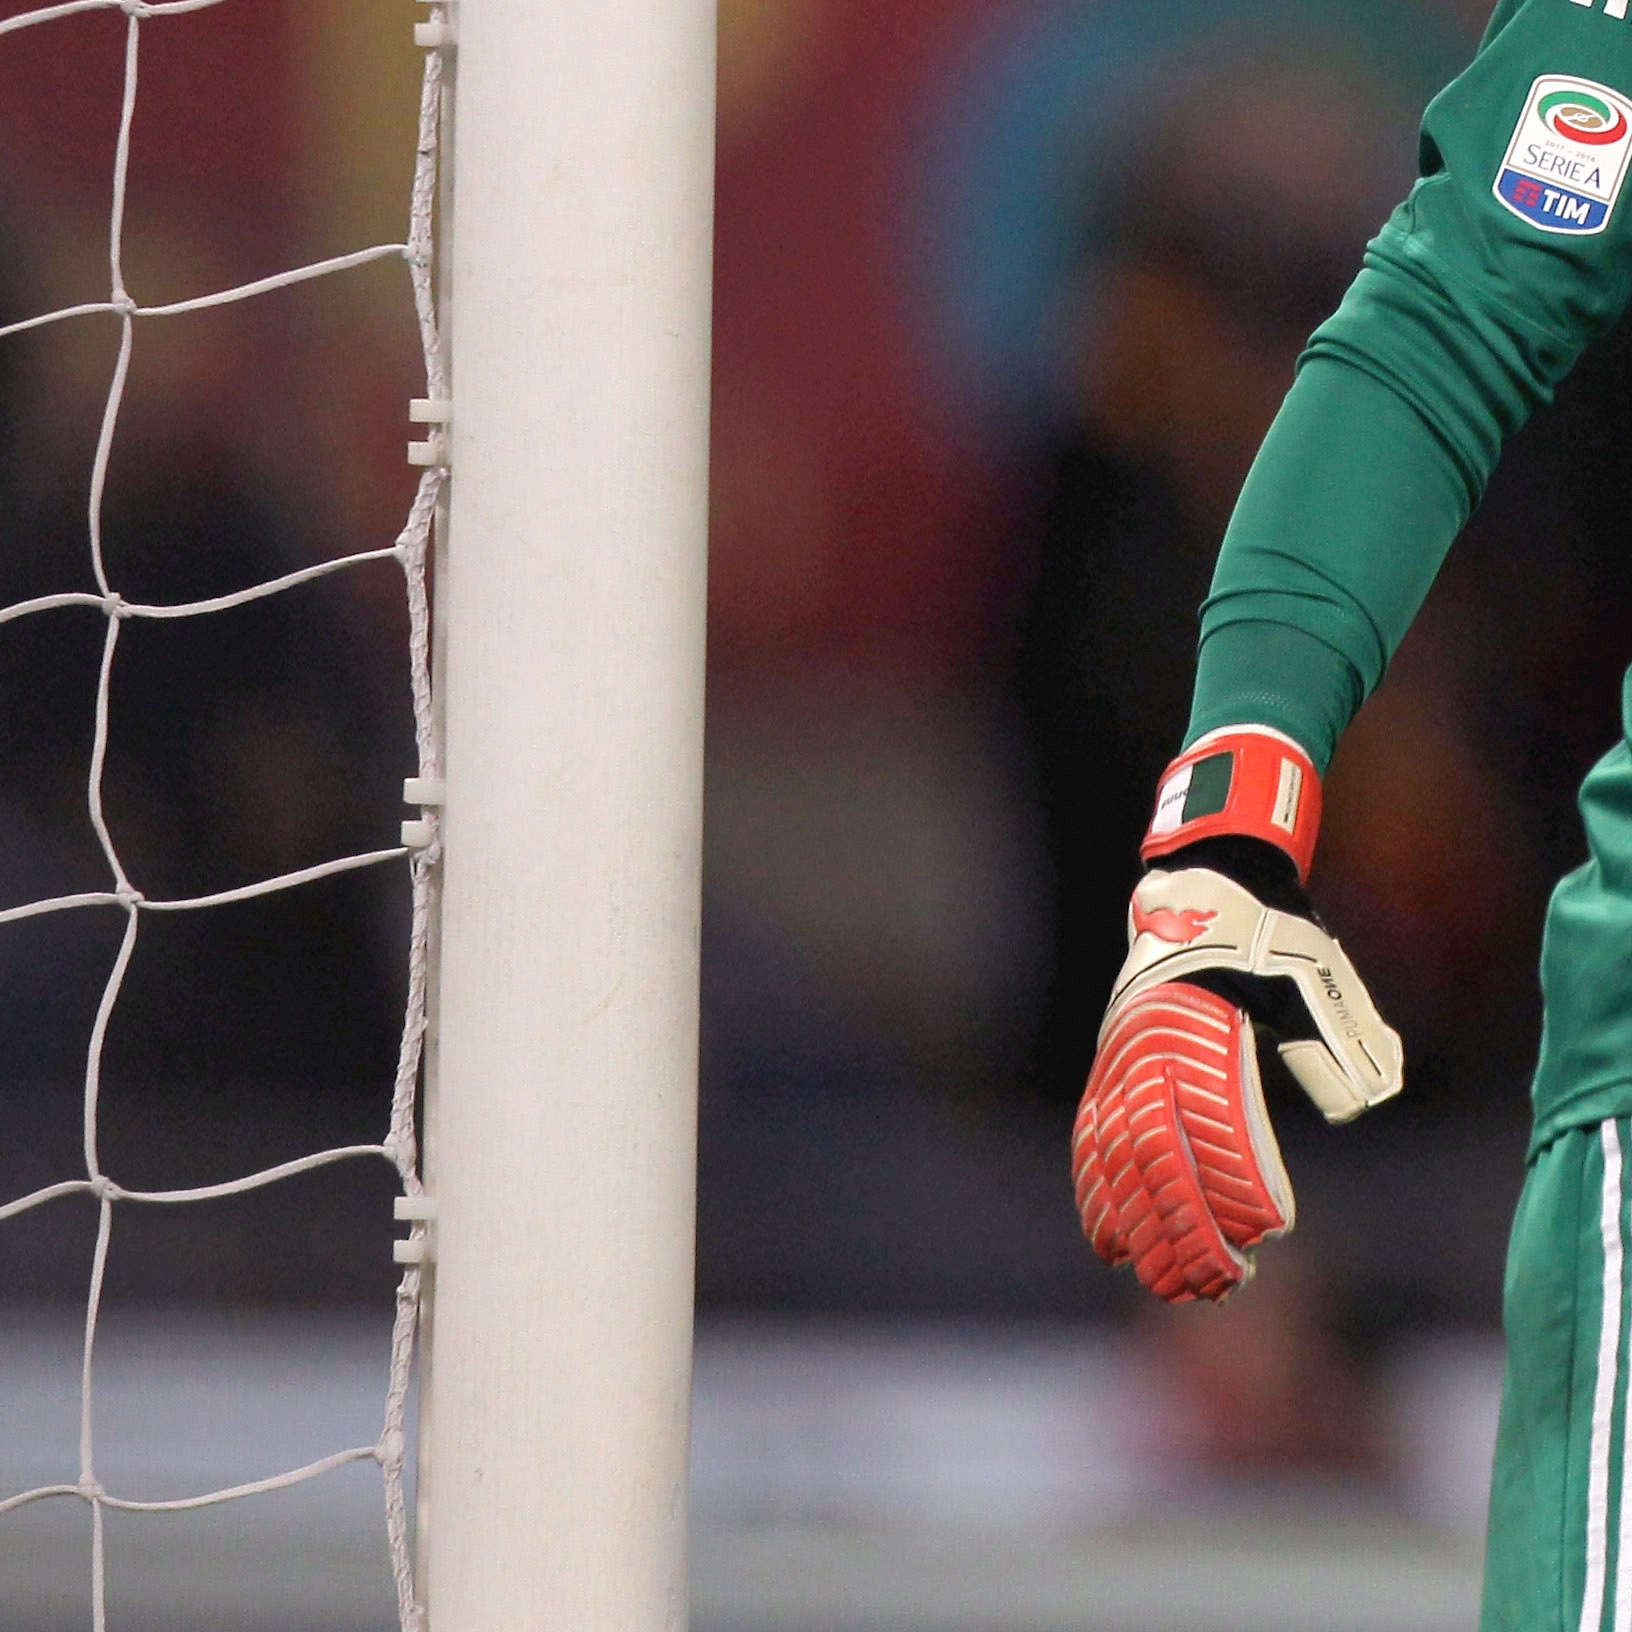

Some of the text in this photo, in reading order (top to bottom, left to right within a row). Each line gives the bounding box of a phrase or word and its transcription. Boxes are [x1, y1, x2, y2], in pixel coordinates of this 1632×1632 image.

[1523, 143, 1600, 189] SERIE A
[1542, 188, 1592, 225] TIM
